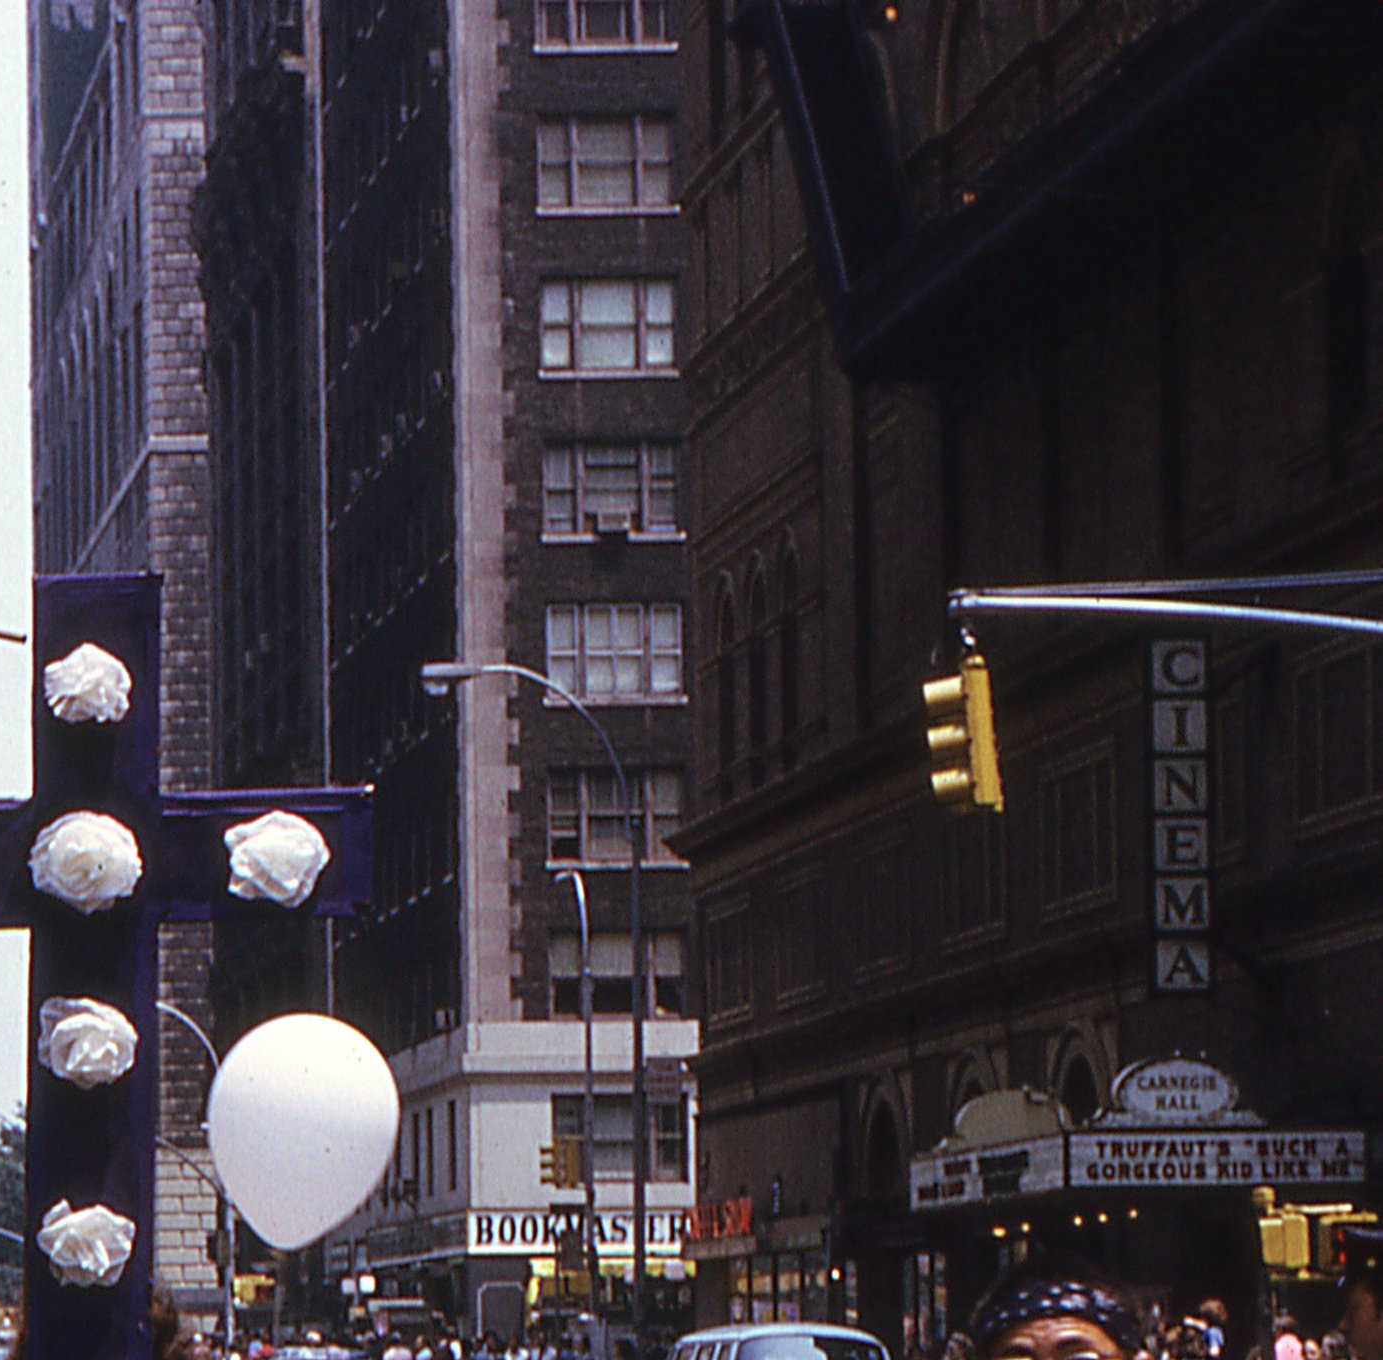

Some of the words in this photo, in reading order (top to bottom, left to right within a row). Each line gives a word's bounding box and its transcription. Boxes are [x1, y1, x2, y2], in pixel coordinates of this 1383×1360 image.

[1161, 646, 1205, 985] CINEMA
[1137, 1075, 1217, 1092] CARNEGIE
[1155, 1096, 1201, 1111] HALL
[1095, 1141, 1232, 1159] TRUFFAUT'S
[1335, 1138, 1348, 1155] A
[1086, 1162, 1206, 1181] GORGEOUS
[1216, 1161, 1253, 1180] KID
[1261, 1160, 1310, 1179] LIKE
[476, 1213, 686, 1246] BOOKMASER
